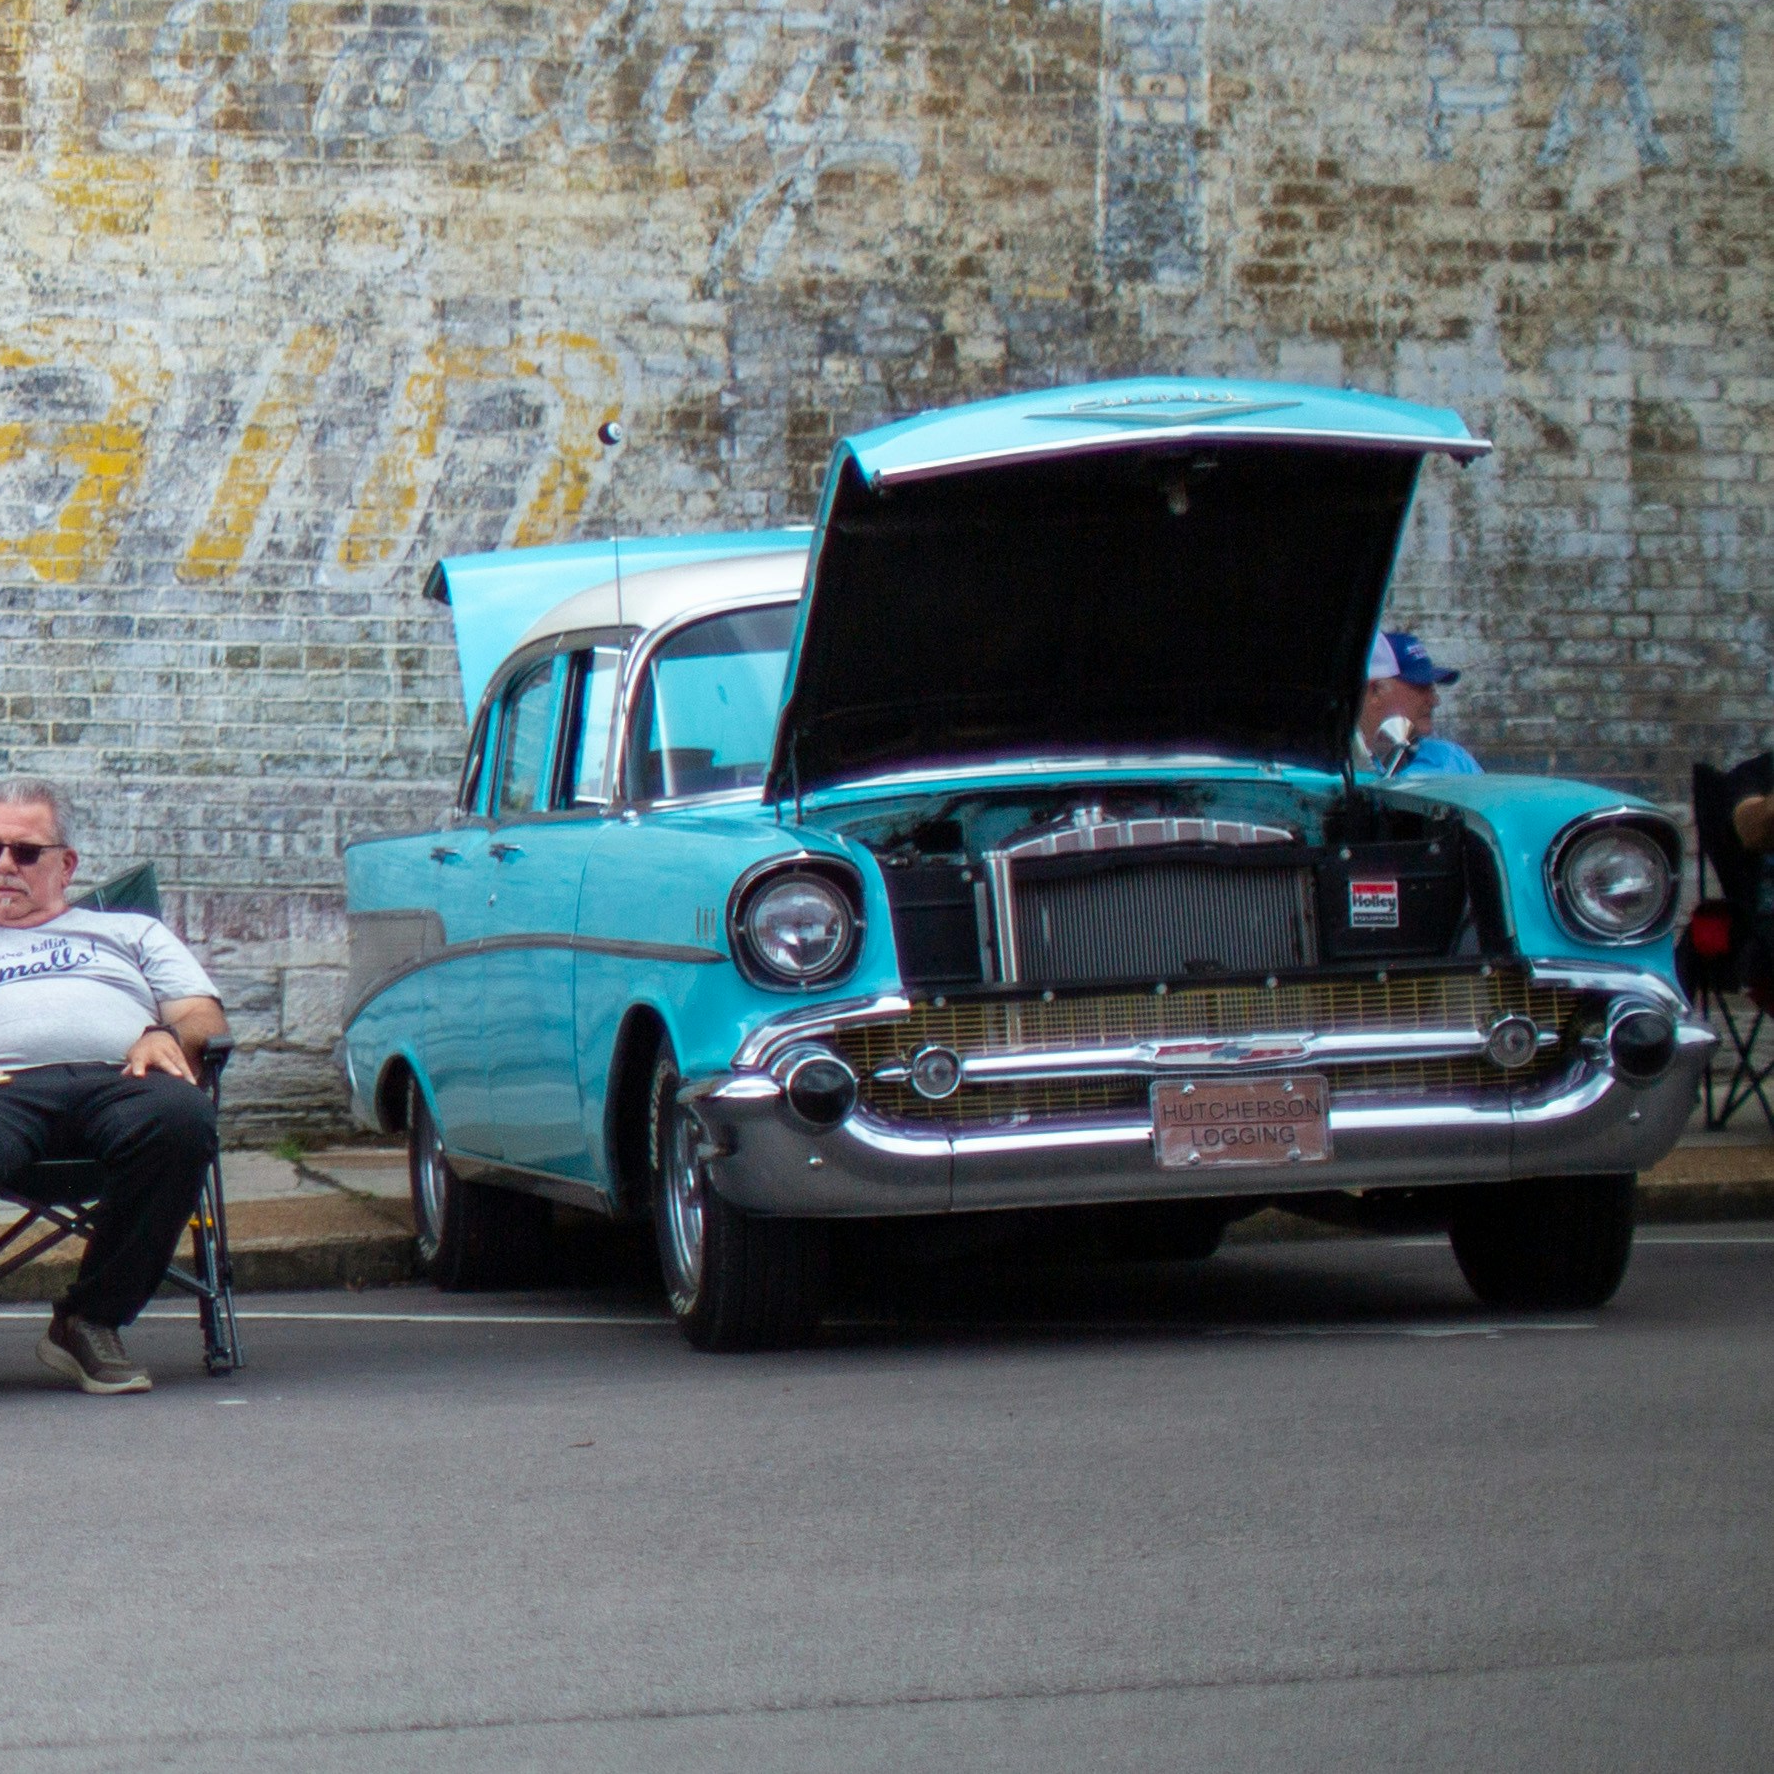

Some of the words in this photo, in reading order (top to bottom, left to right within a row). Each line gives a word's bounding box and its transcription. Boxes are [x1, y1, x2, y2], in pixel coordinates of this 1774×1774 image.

[1352, 894, 1397, 913] Holley
[1162, 1097, 1322, 1122] HUTCHERSON
[1190, 1125, 1296, 1147] LOGGING
